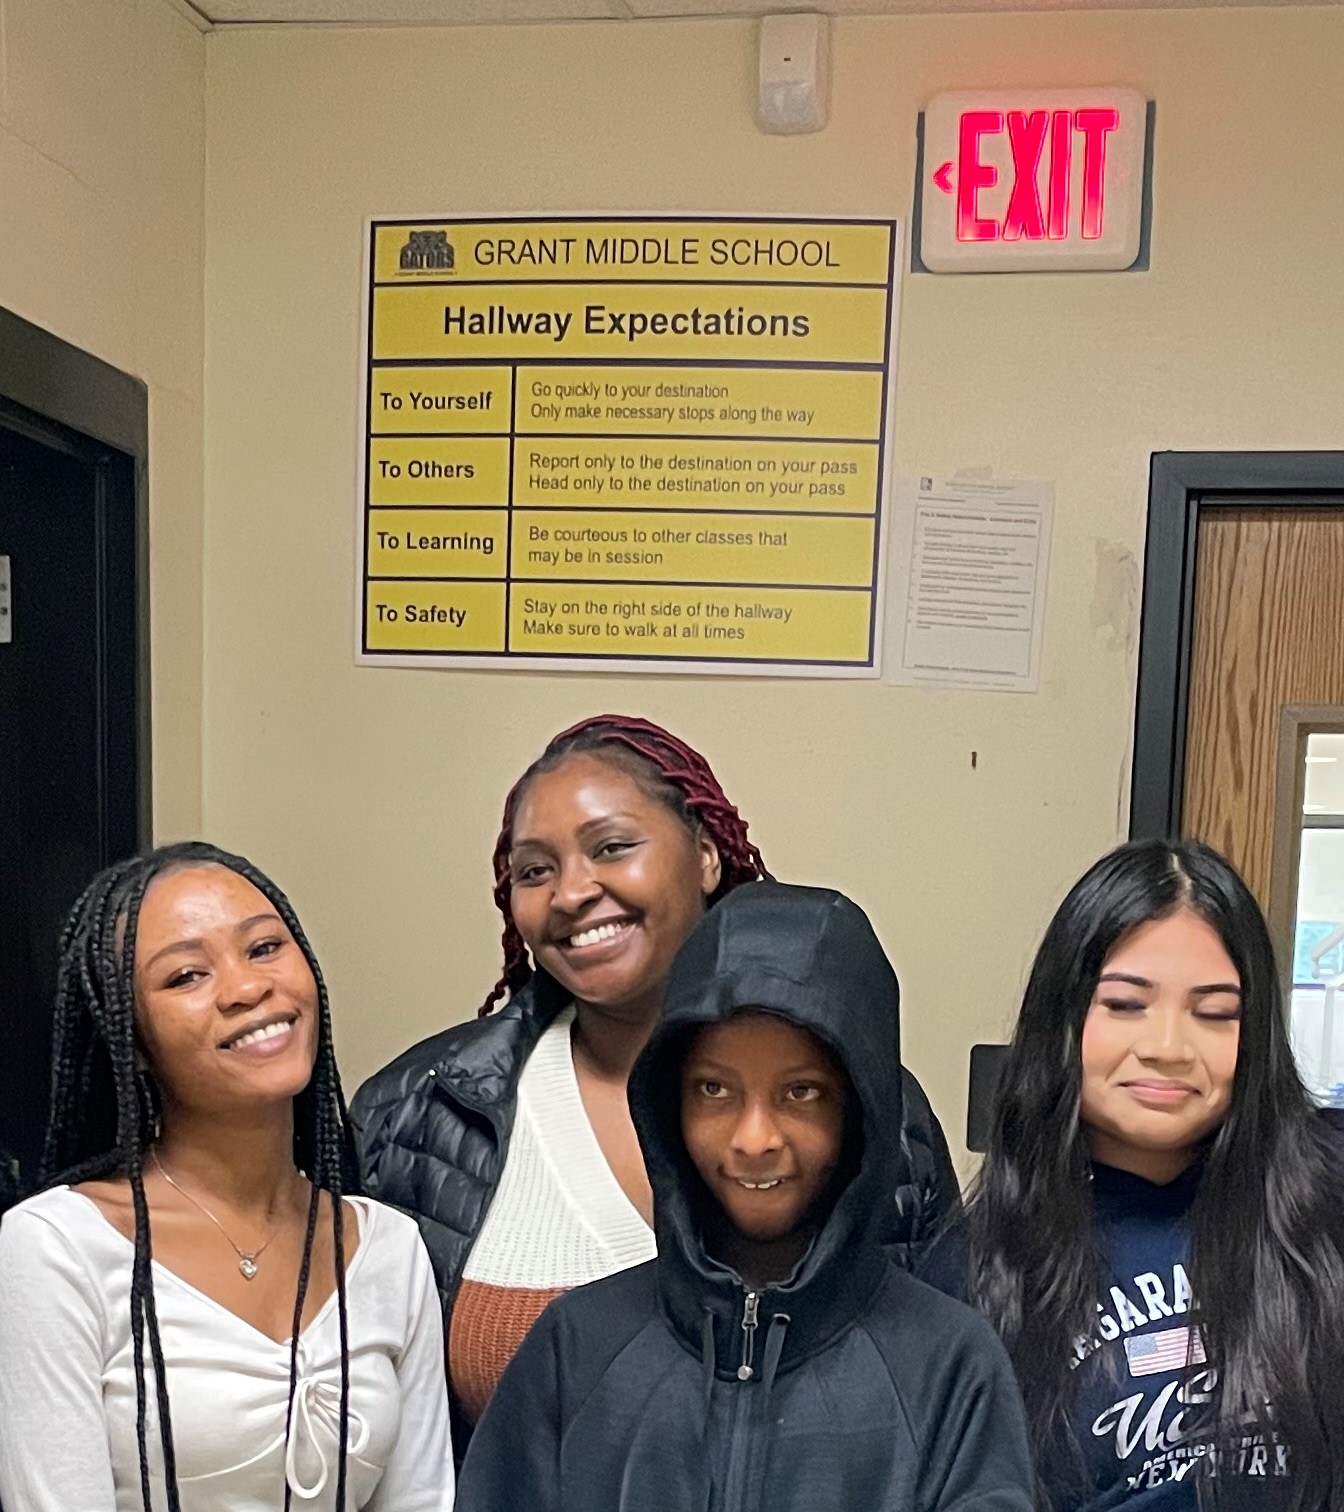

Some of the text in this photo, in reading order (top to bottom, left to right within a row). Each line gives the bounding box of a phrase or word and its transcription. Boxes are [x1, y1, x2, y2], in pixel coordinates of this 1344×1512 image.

[957, 109, 1120, 242] EXIT
[474, 238, 840, 267] GRANT MIDDLE SCHOOL
[444, 305, 810, 342] Hallway Expectations
[380, 391, 492, 410] To Yourself
[531, 382, 729, 401] Go quickly to your destination
[531, 403, 815, 426] Only make necessary stops along the way
[379, 460, 475, 478] To Others
[530, 453, 858, 476] Report only to the destination on your pass
[529, 475, 846, 498] Head only to the destination on your pass
[377, 532, 494, 555] To Learning
[529, 526, 788, 547] Be courteous to other classes that
[528, 549, 664, 566] may be in session
[376, 604, 467, 627] To Safety
[524, 599, 793, 624] Stay on the right side of the hallway
[523, 620, 745, 640] Make sure to walk at all times
[1126, 1456, 1199, 1492] NEW
